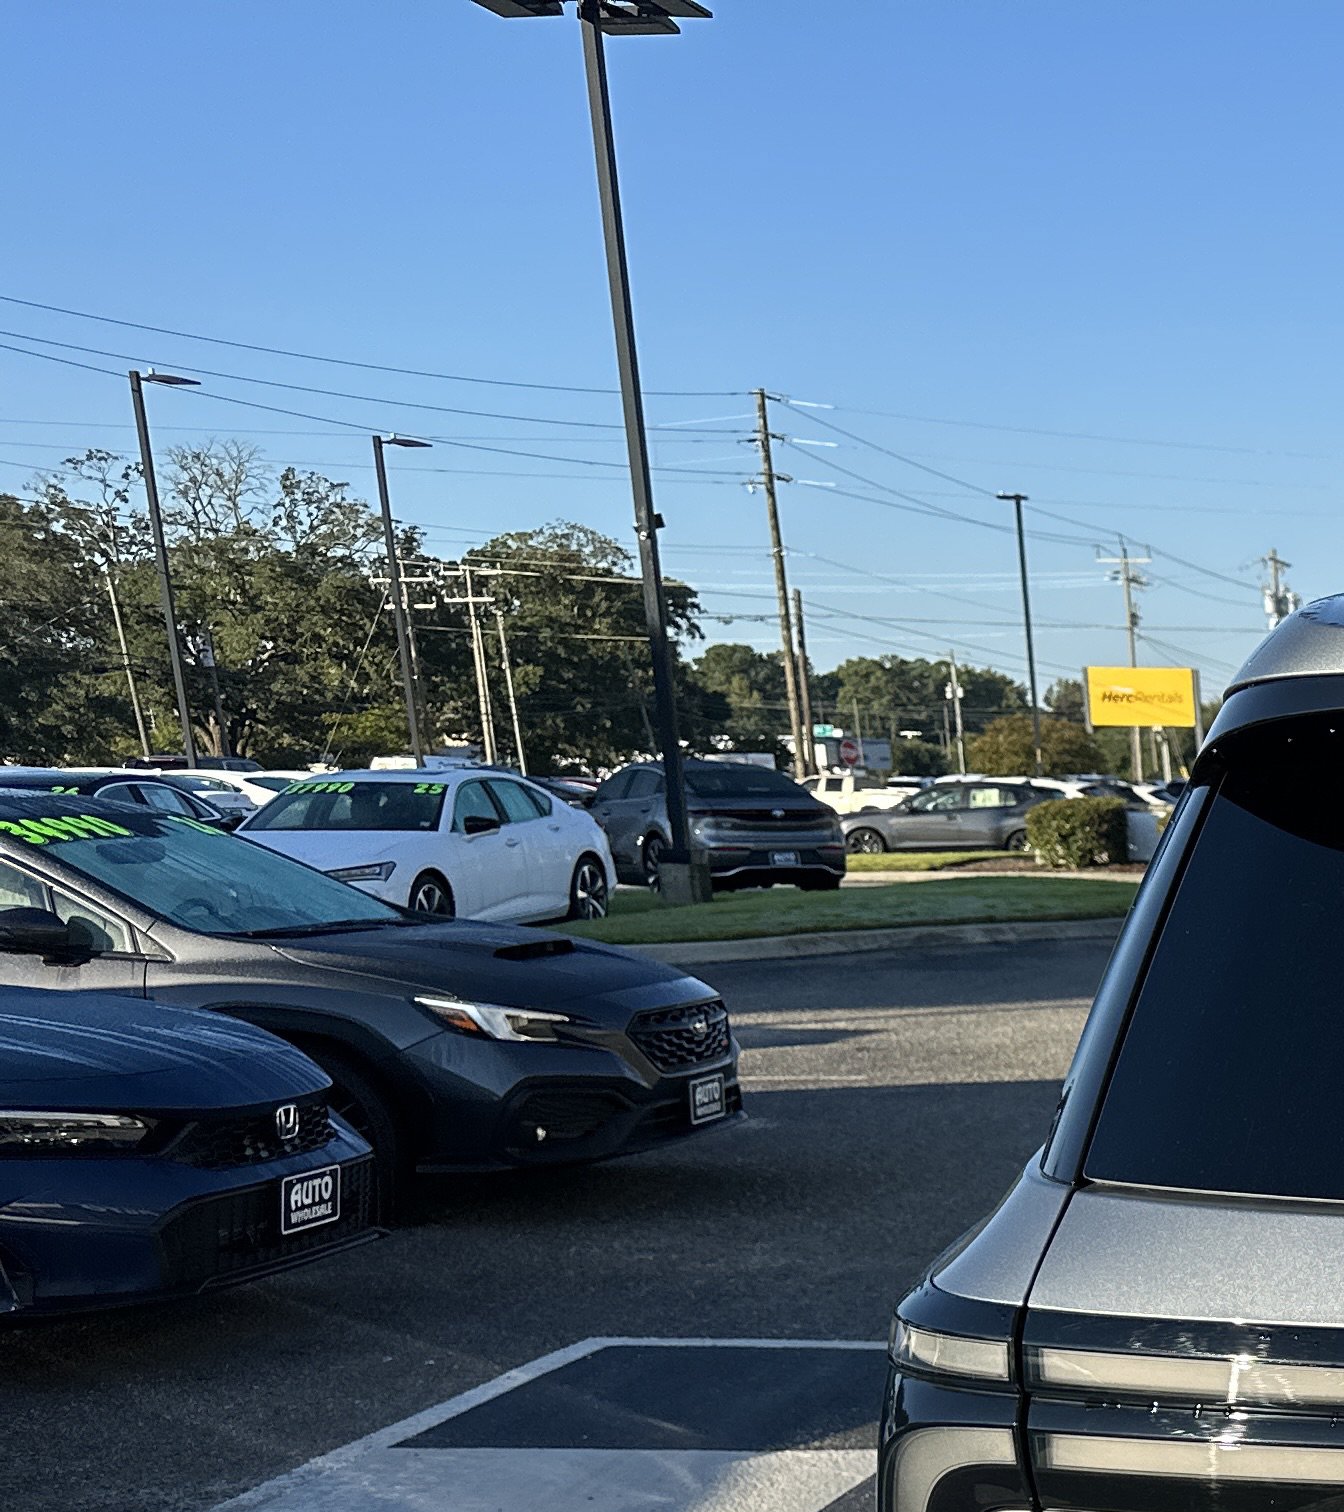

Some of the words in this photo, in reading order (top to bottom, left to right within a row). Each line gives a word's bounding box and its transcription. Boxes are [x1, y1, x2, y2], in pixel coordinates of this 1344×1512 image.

[413, 783, 445, 795] 25
[290, 1175, 333, 1211] AUTO
[290, 1201, 333, 1224] WHOLESALE
